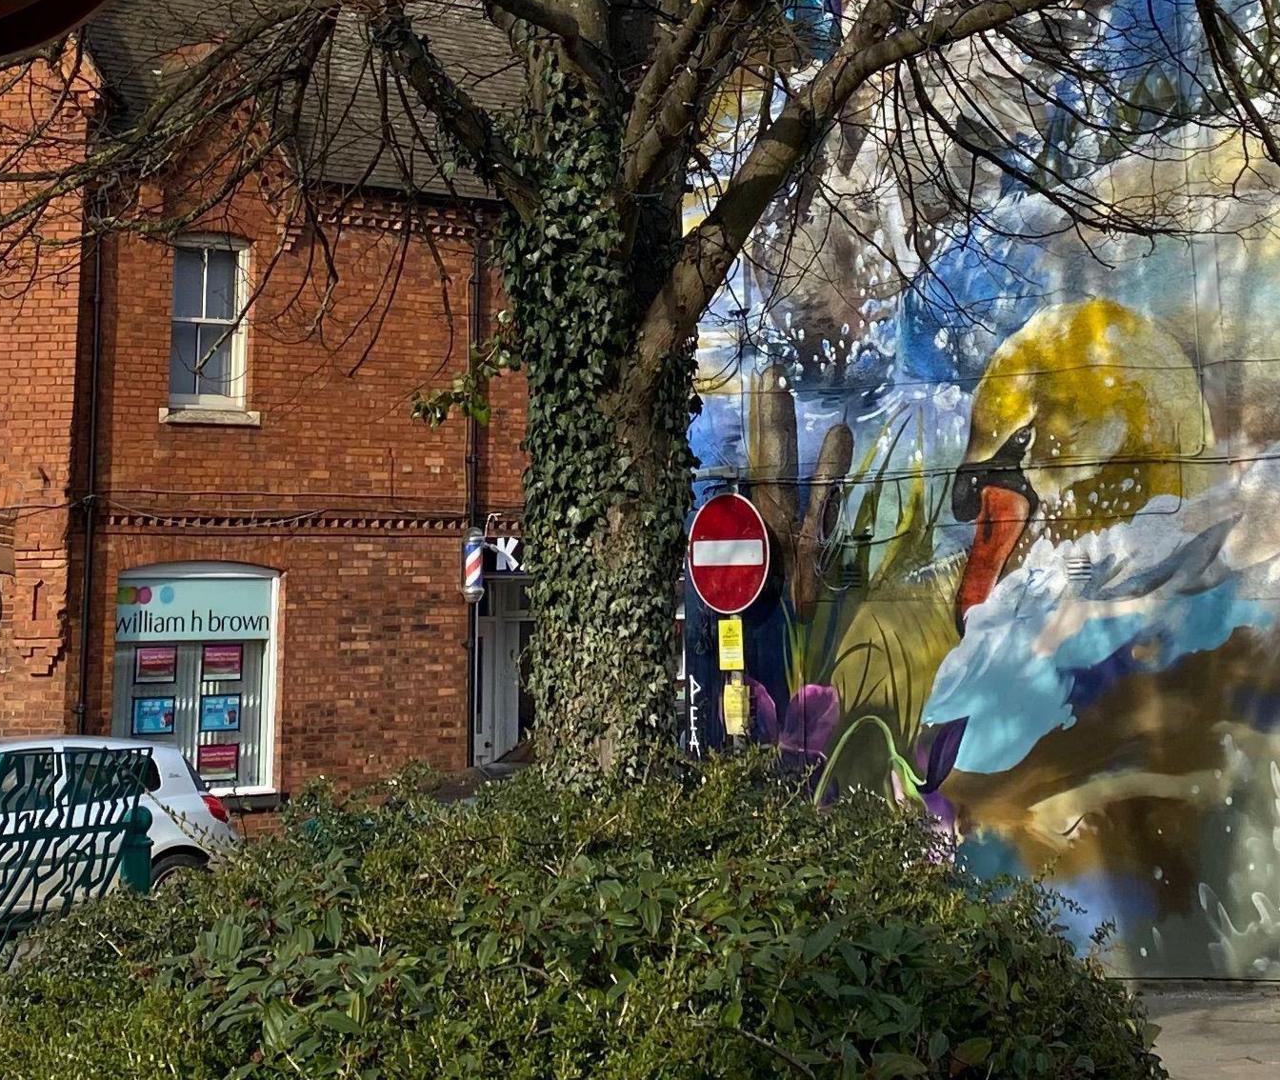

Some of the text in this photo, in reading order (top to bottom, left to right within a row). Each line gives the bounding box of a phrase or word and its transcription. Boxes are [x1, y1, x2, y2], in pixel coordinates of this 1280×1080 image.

[116, 609, 269, 633] william h brown
